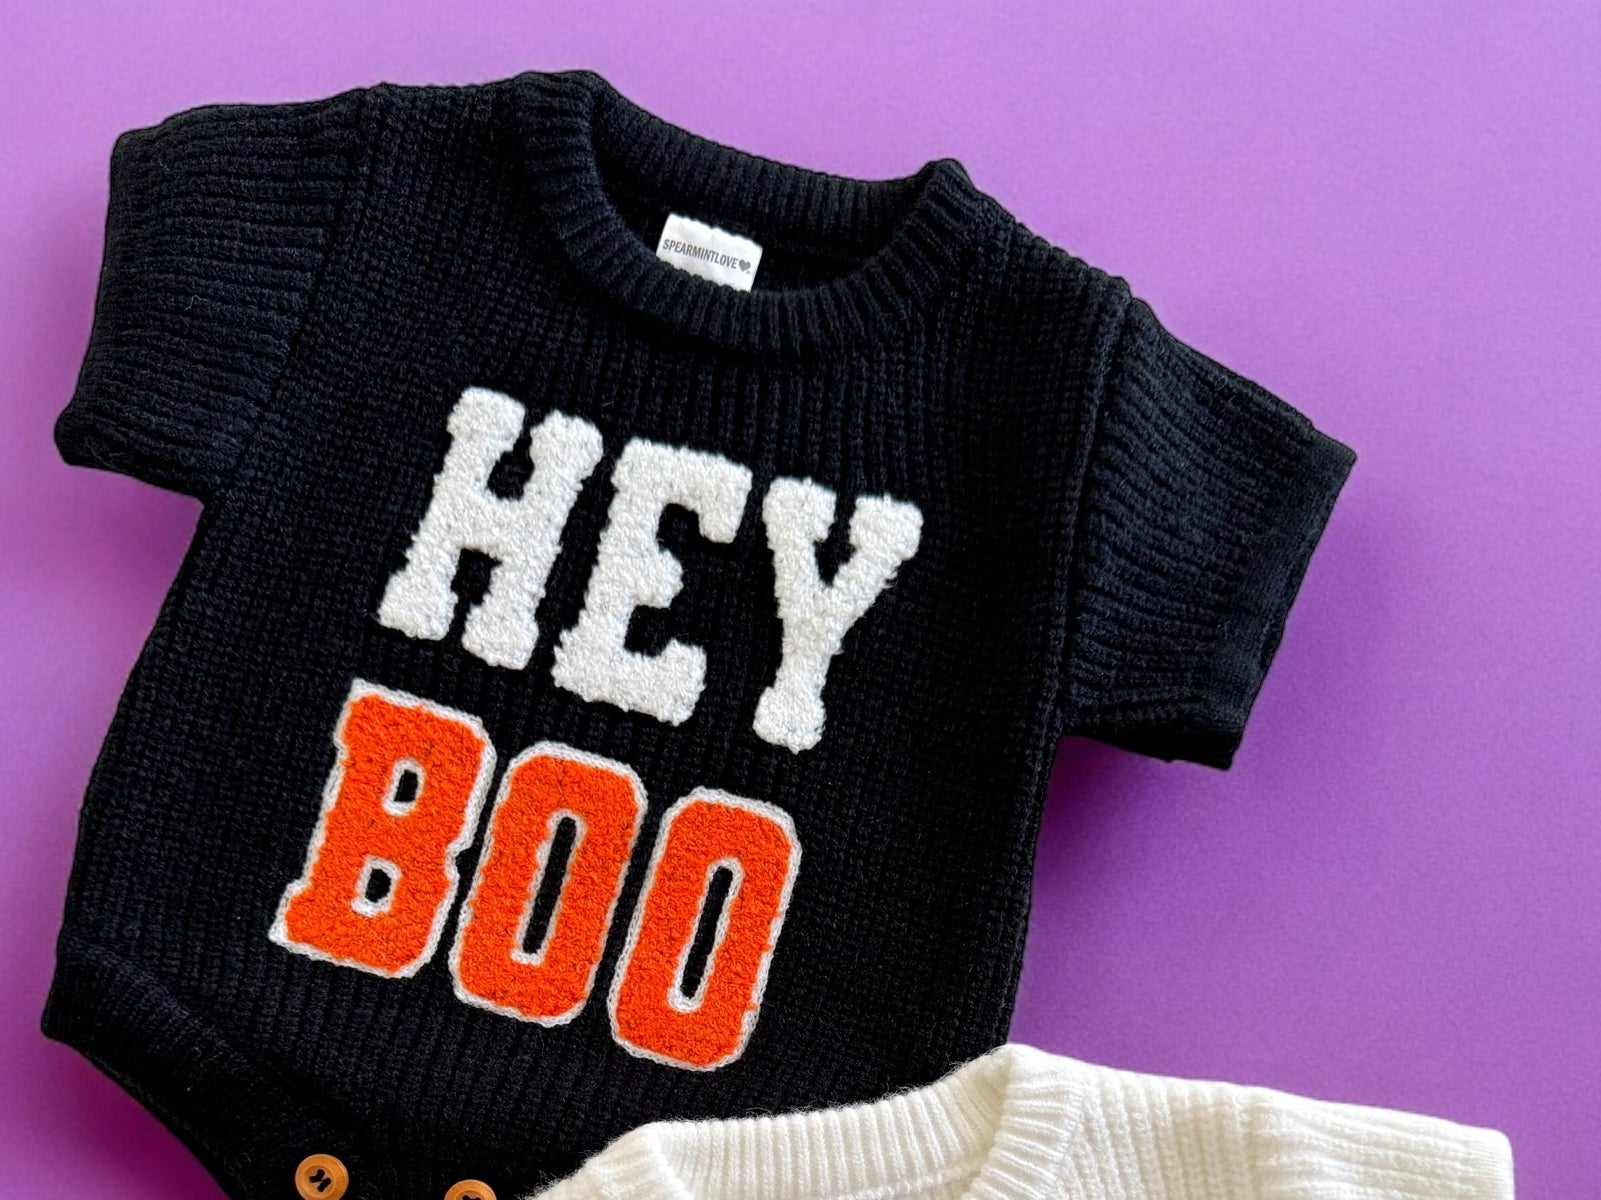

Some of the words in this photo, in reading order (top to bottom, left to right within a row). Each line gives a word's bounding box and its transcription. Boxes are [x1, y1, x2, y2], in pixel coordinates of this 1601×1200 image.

[662, 238, 739, 269] SPEARMINTLOVE
[377, 385, 923, 753] HEY
[268, 678, 802, 1070] BOO
